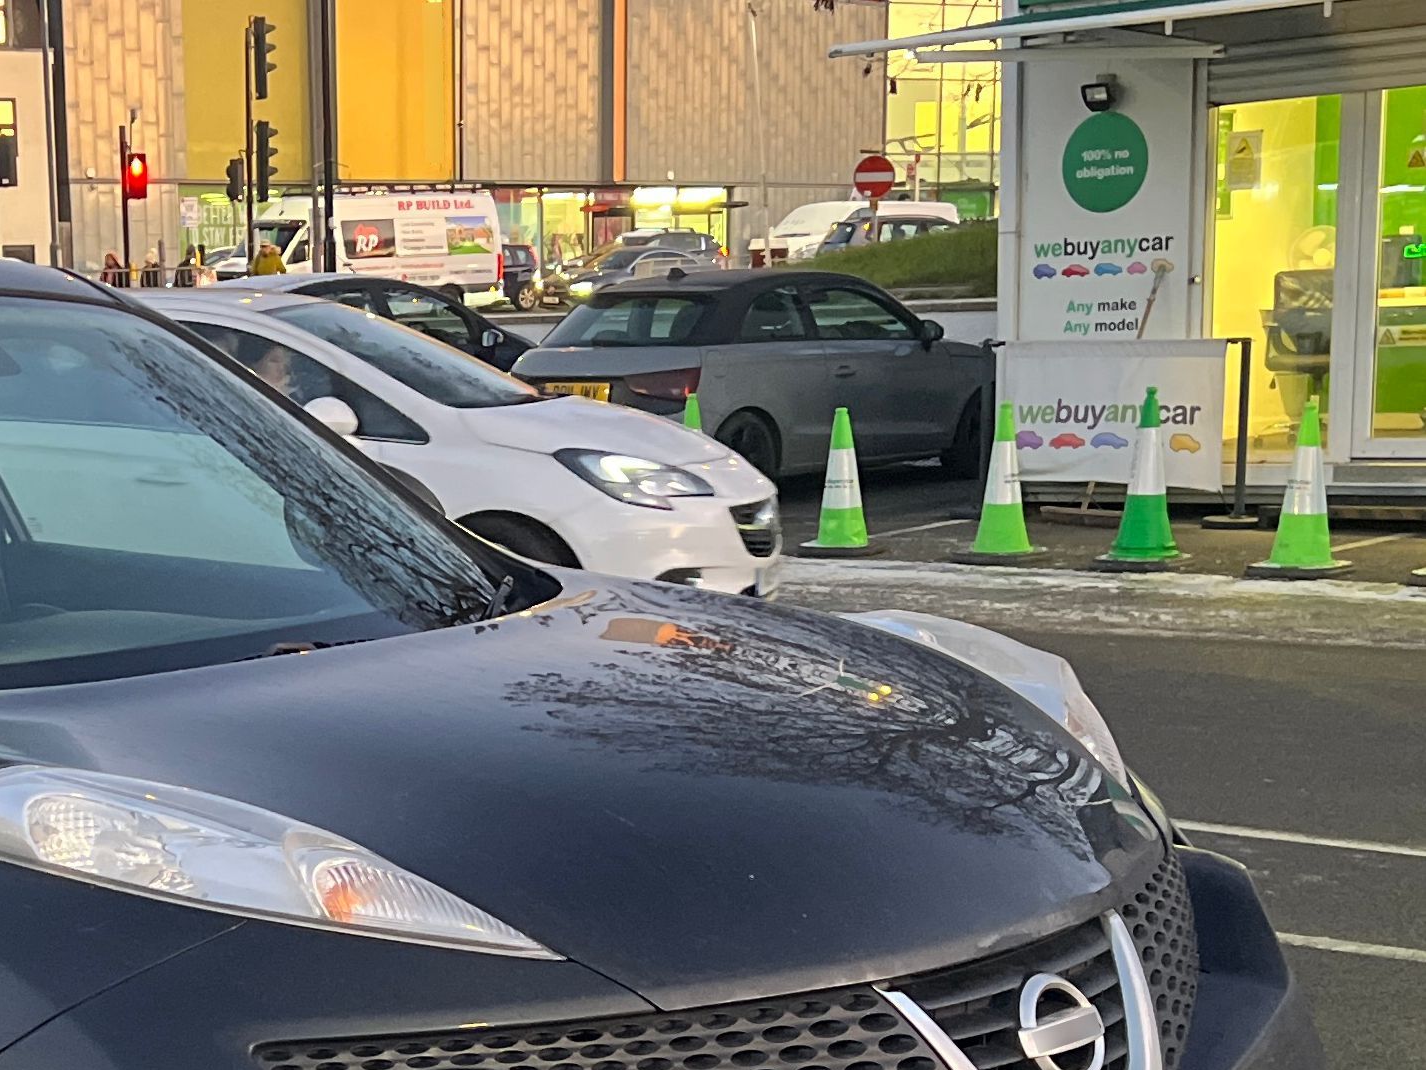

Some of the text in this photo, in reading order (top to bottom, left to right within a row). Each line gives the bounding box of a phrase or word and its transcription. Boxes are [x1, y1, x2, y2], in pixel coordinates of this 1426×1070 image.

[1081, 150, 1129, 161] 100% no
[1076, 164, 1134, 179] obligation
[397, 200, 413, 211] RP
[415, 199, 451, 211] BUILD
[355, 234, 379, 253] RP
[1034, 235, 1174, 260] webuyanycar
[1066, 298, 1137, 316] Any make
[1063, 318, 1139, 336] Any model
[1018, 398, 1202, 430] webuyancar
